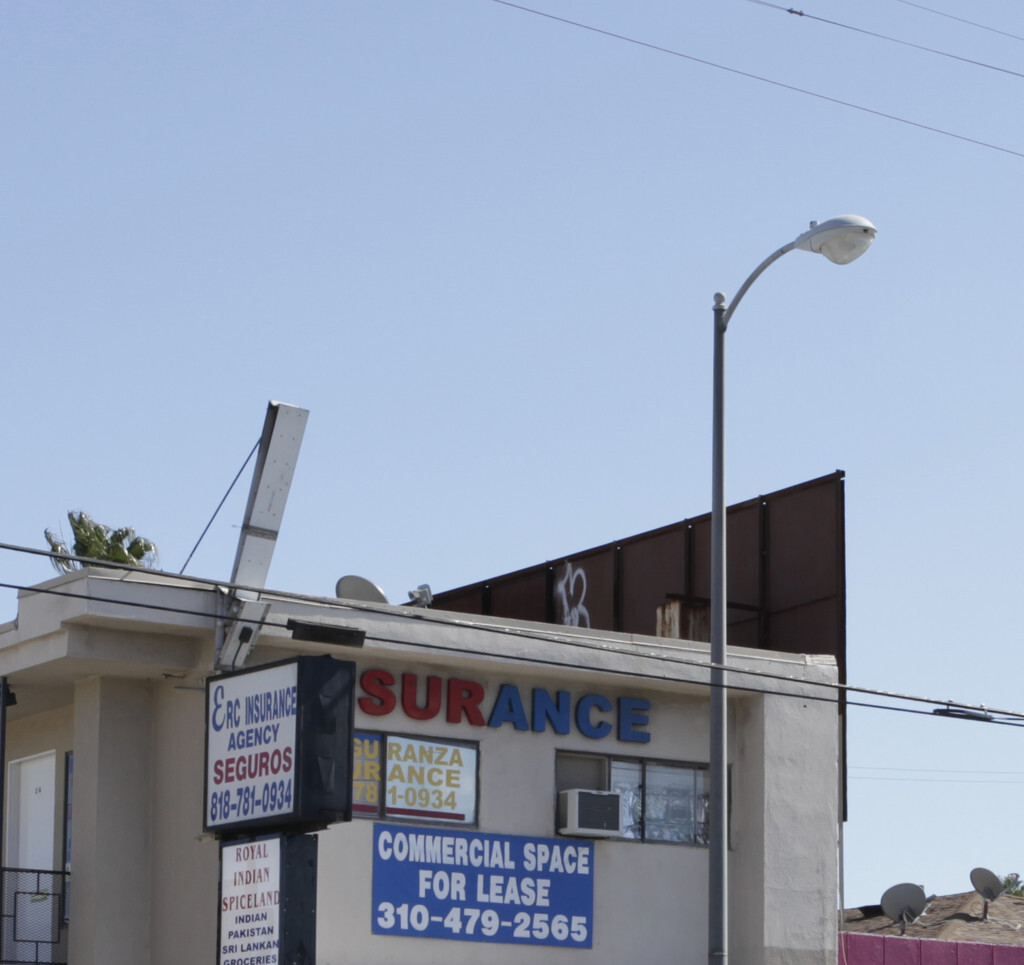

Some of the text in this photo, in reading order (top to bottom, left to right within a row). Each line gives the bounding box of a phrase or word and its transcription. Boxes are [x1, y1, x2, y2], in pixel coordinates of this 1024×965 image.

[245, 686, 296, 726] INSURANCE
[228, 723, 280, 751] AGENCY
[213, 746, 292, 785] SEGUROS
[211, 779, 292, 821] 818-781-0934
[236, 844, 268, 862] ROYAL
[378, 831, 590, 875] COMMERCIAL SPACE
[234, 867, 270, 886] INDIAN
[419, 870, 551, 907] FOR LEASE
[222, 890, 280, 911] SPICELAND
[235, 912, 267, 924] INDIAN
[377, 902, 588, 942] 310-479-2565
[228, 926, 274, 939] PAKISTAN
[222, 940, 280, 955] SRI LANKAN
